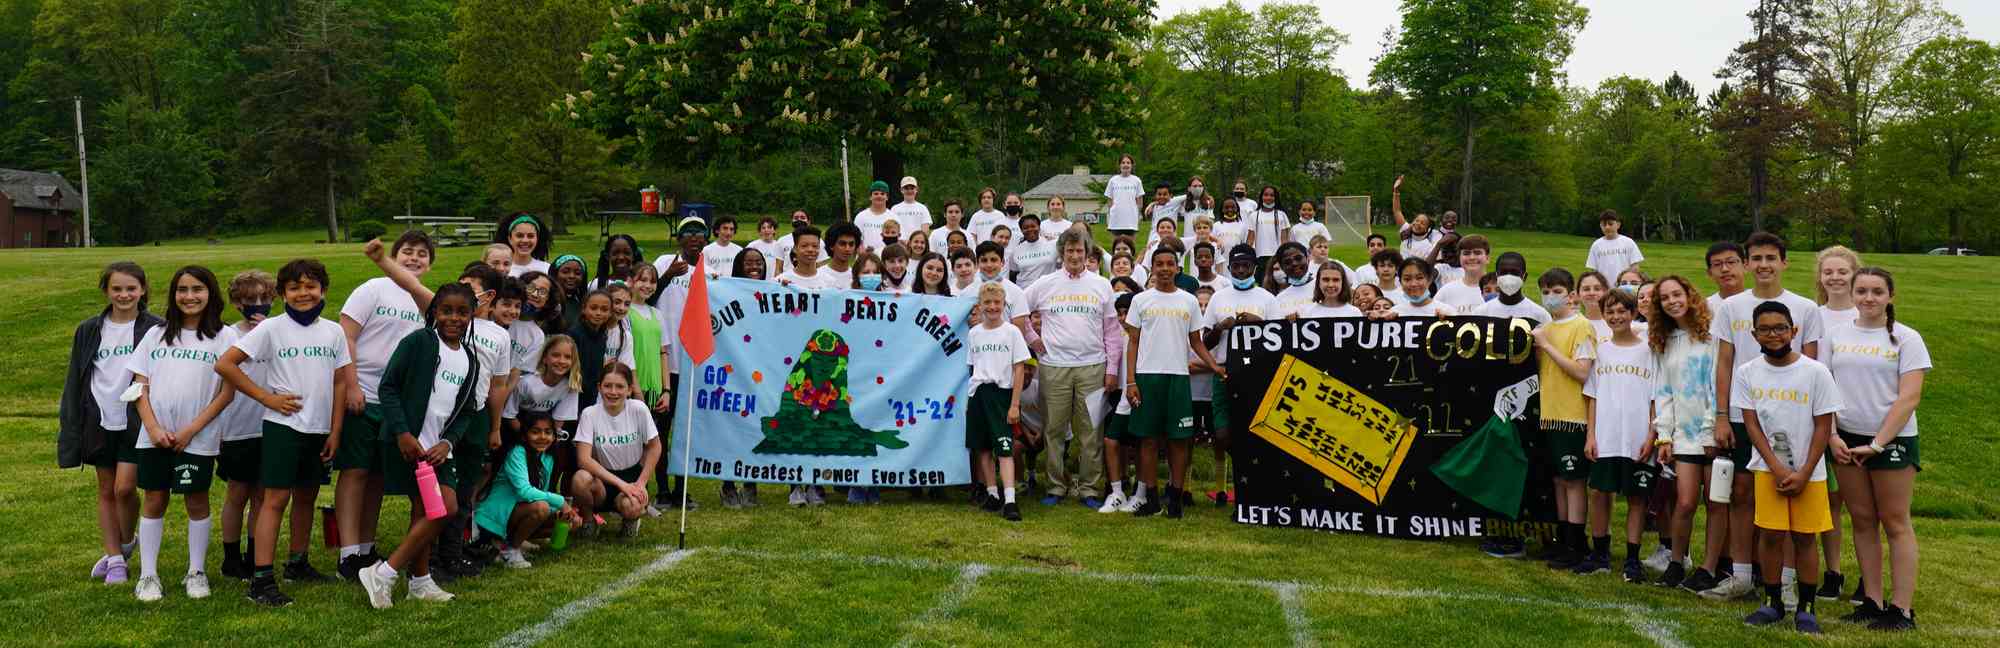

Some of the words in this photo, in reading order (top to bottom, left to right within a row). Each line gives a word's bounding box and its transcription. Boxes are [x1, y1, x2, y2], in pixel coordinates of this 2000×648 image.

[376, 306, 397, 316] GO
[757, 292, 820, 314] HEART
[844, 298, 898, 322] BEATS
[914, 307, 963, 357] GREEN
[1292, 319, 1321, 351] IS
[1334, 319, 1423, 349] PURE
[1425, 318, 1535, 364] GOLD
[704, 364, 729, 386] GO
[696, 388, 757, 414] GREEN
[1276, 374, 1308, 413] TPS
[695, 457, 722, 475] The
[733, 460, 804, 482] Greatest
[908, 468, 945, 485] Seen
[1237, 503, 1291, 526] LET'S
[1300, 508, 1364, 532] MAKE
[1376, 514, 1398, 535] IT
[1409, 515, 1482, 537] SHINE
